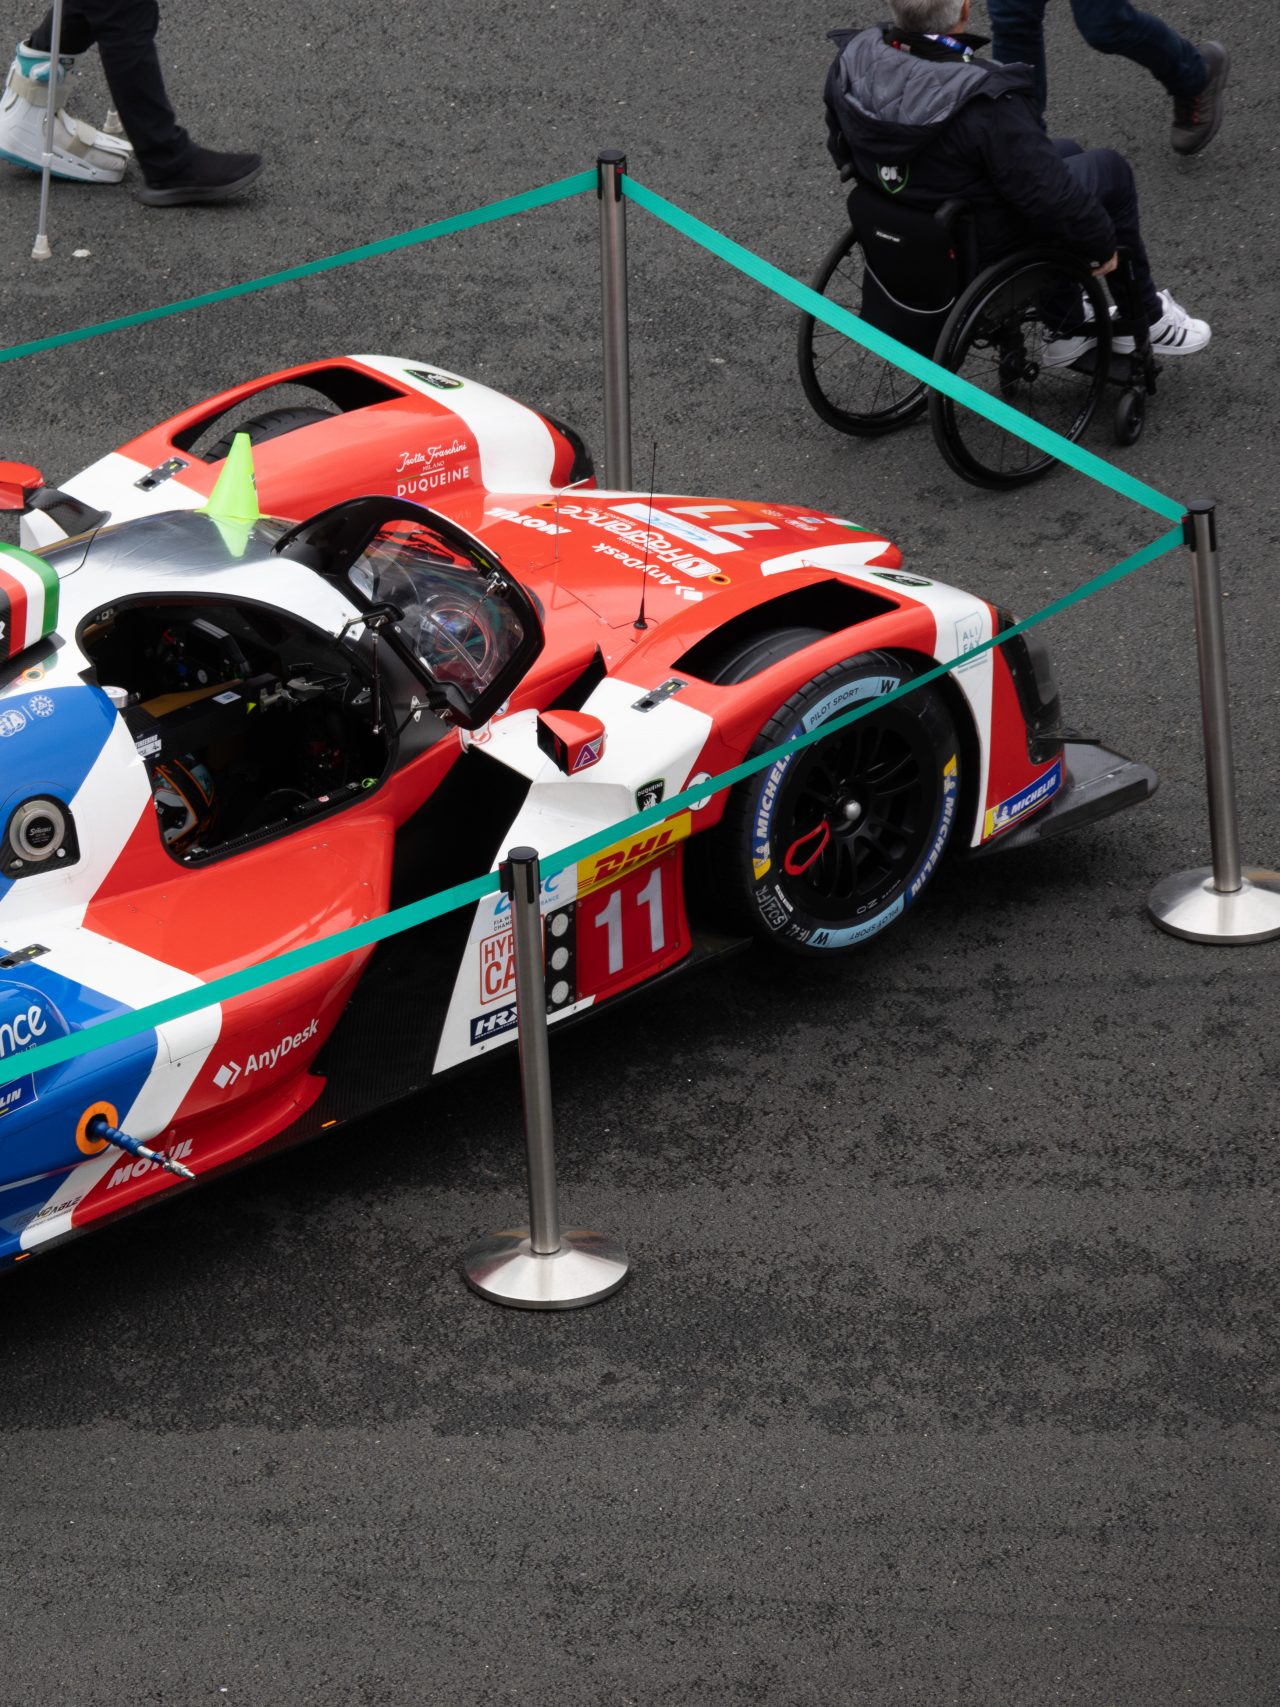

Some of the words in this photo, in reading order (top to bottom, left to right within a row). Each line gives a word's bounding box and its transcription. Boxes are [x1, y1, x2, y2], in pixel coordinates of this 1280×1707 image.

[397, 466, 469, 497] DUQUEINE
[483, 507, 572, 536] MOTUL
[591, 542, 680, 585] AnyDesk
[809, 703, 832, 725] PILOT
[833, 687, 860, 707] SPORT
[880, 679, 896, 694] W
[637, 781, 664, 798] DUQUEINE
[1010, 774, 1057, 815] MICHELIN
[593, 829, 674, 883] DHL
[911, 797, 954, 897] MICHELIN
[595, 866, 665, 975] 11
[484, 954, 517, 995] CA
[244, 1018, 319, 1077] AnyDesk
